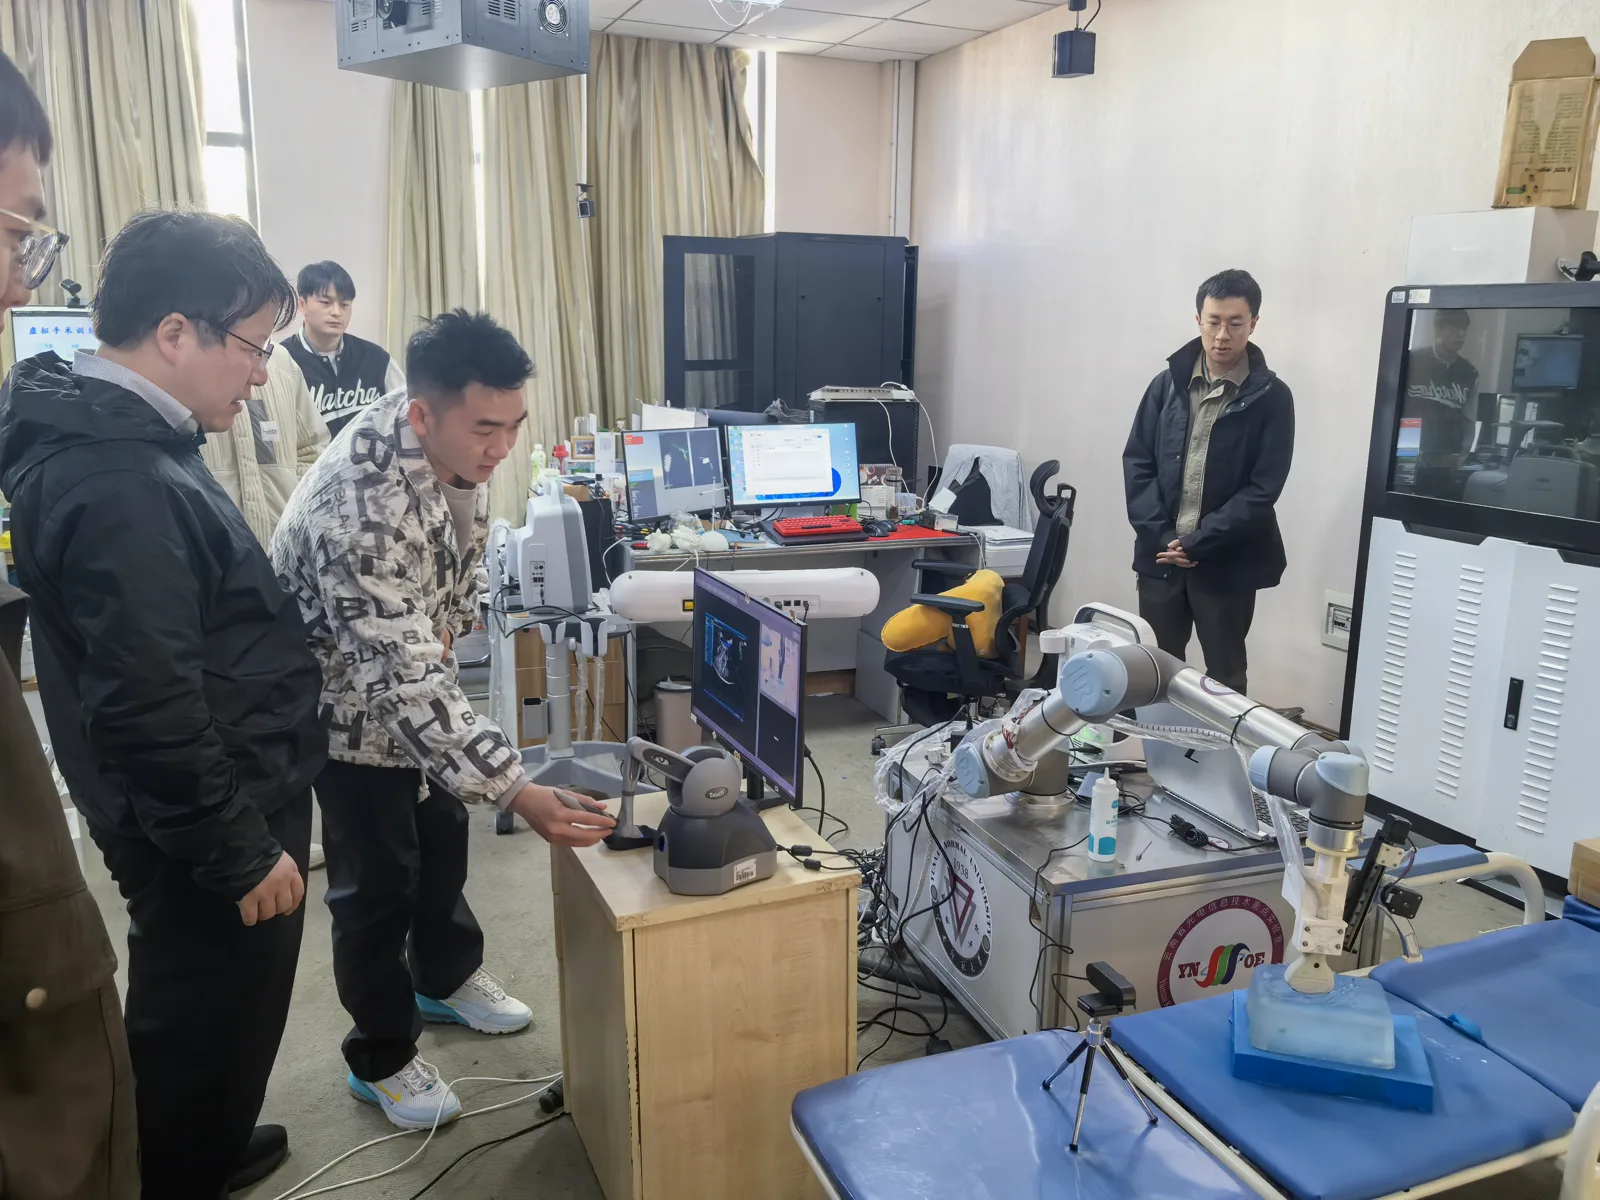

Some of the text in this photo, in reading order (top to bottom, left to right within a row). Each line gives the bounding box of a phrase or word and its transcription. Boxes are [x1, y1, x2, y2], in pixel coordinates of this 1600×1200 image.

[342, 639, 399, 667] BLAH
[708, 789, 726, 799] Touch
[953, 857, 969, 880] 1938
[943, 839, 967, 858] NORMAL
[969, 857, 992, 937] UNIVERSITY
